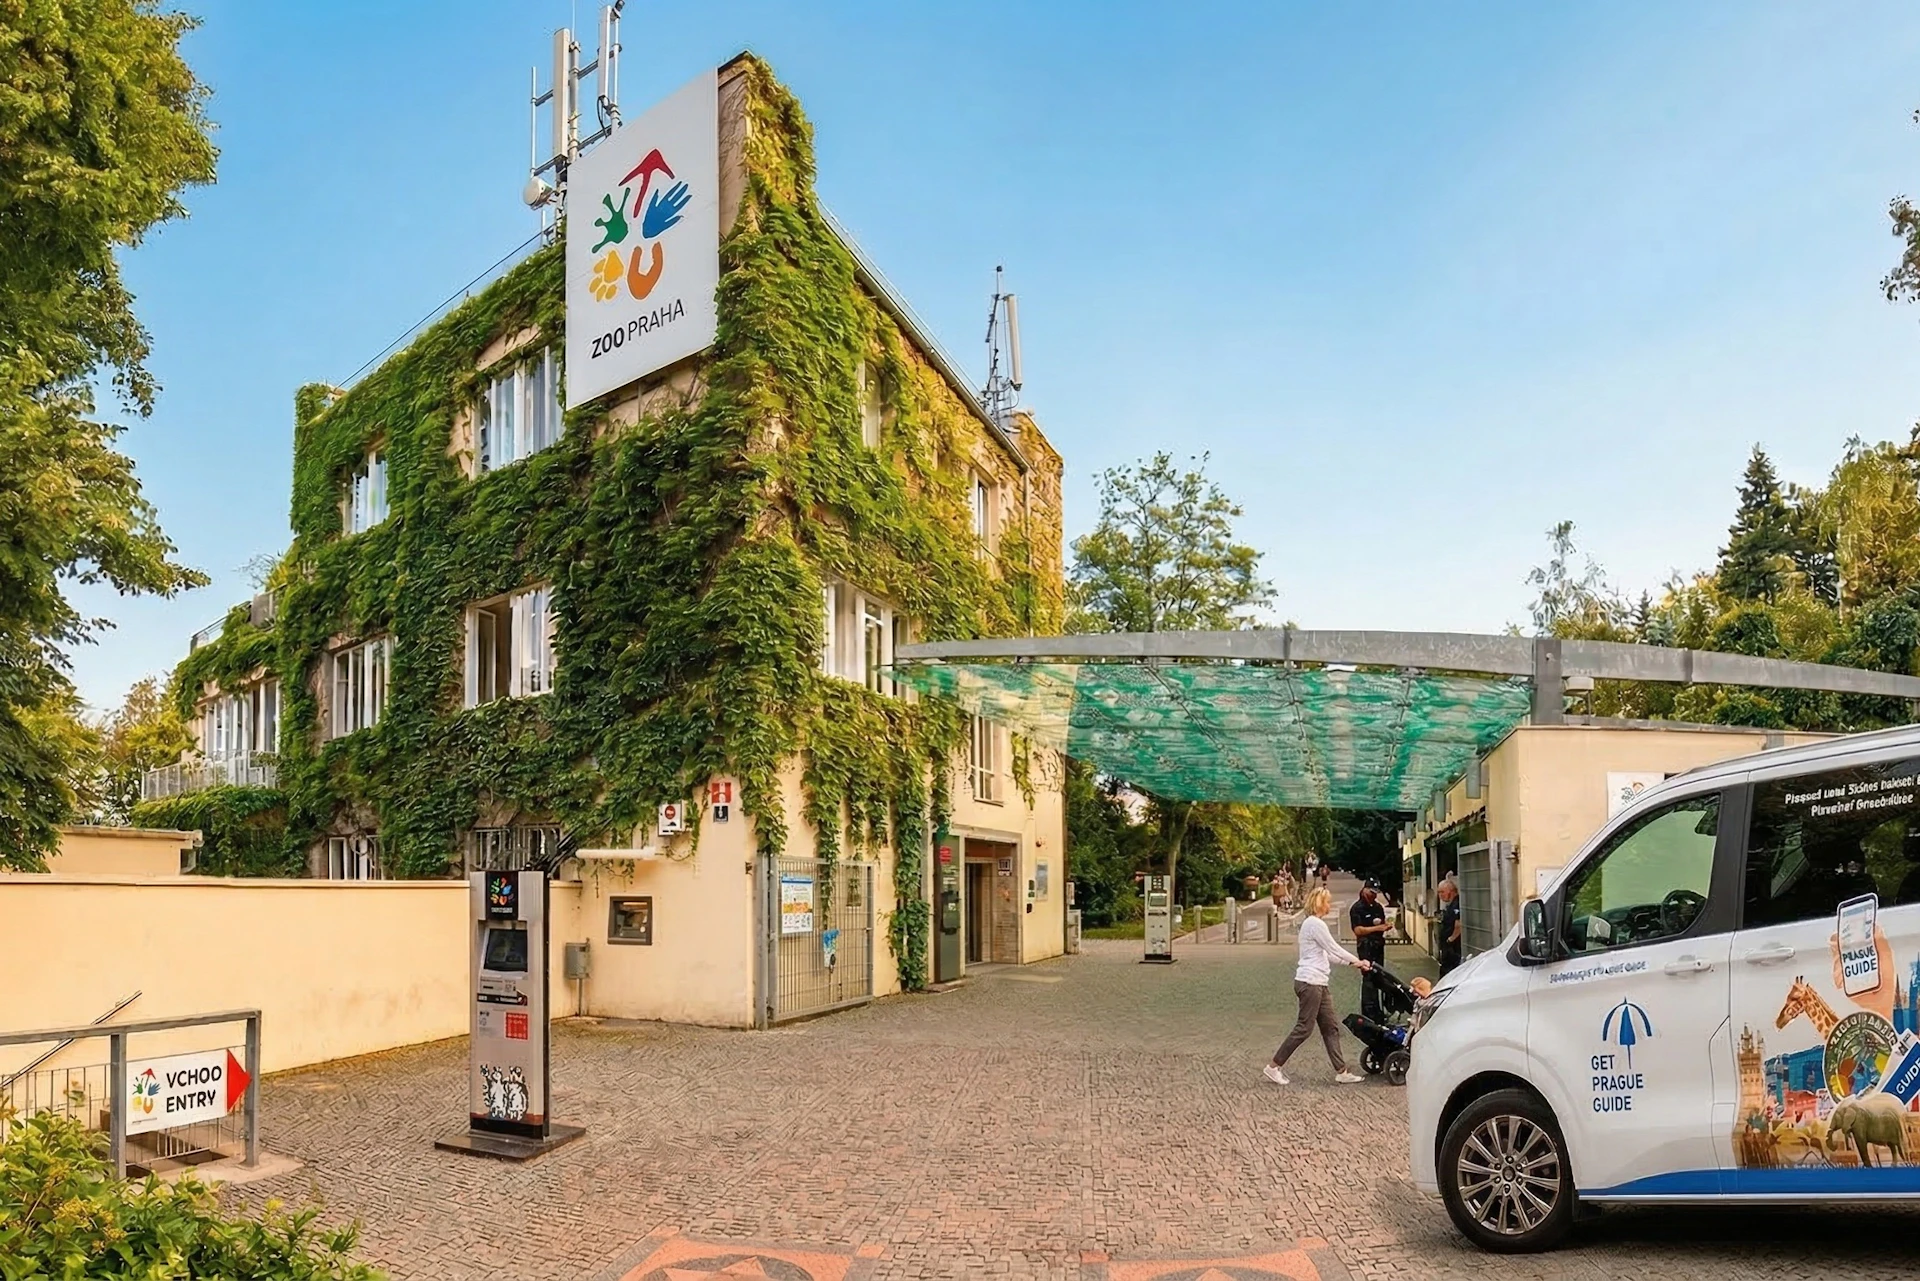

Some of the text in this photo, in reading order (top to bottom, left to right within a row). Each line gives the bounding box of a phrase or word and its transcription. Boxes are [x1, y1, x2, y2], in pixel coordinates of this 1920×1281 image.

[591, 299, 685, 359] ZOO PRAHA
[1844, 958, 1878, 978] GUIDE
[1591, 1054, 1615, 1071] GET
[1592, 1073, 1644, 1092] PRAGUE
[166, 1089, 217, 1113] ENTRY
[1593, 1096, 1632, 1113] GUIDE
